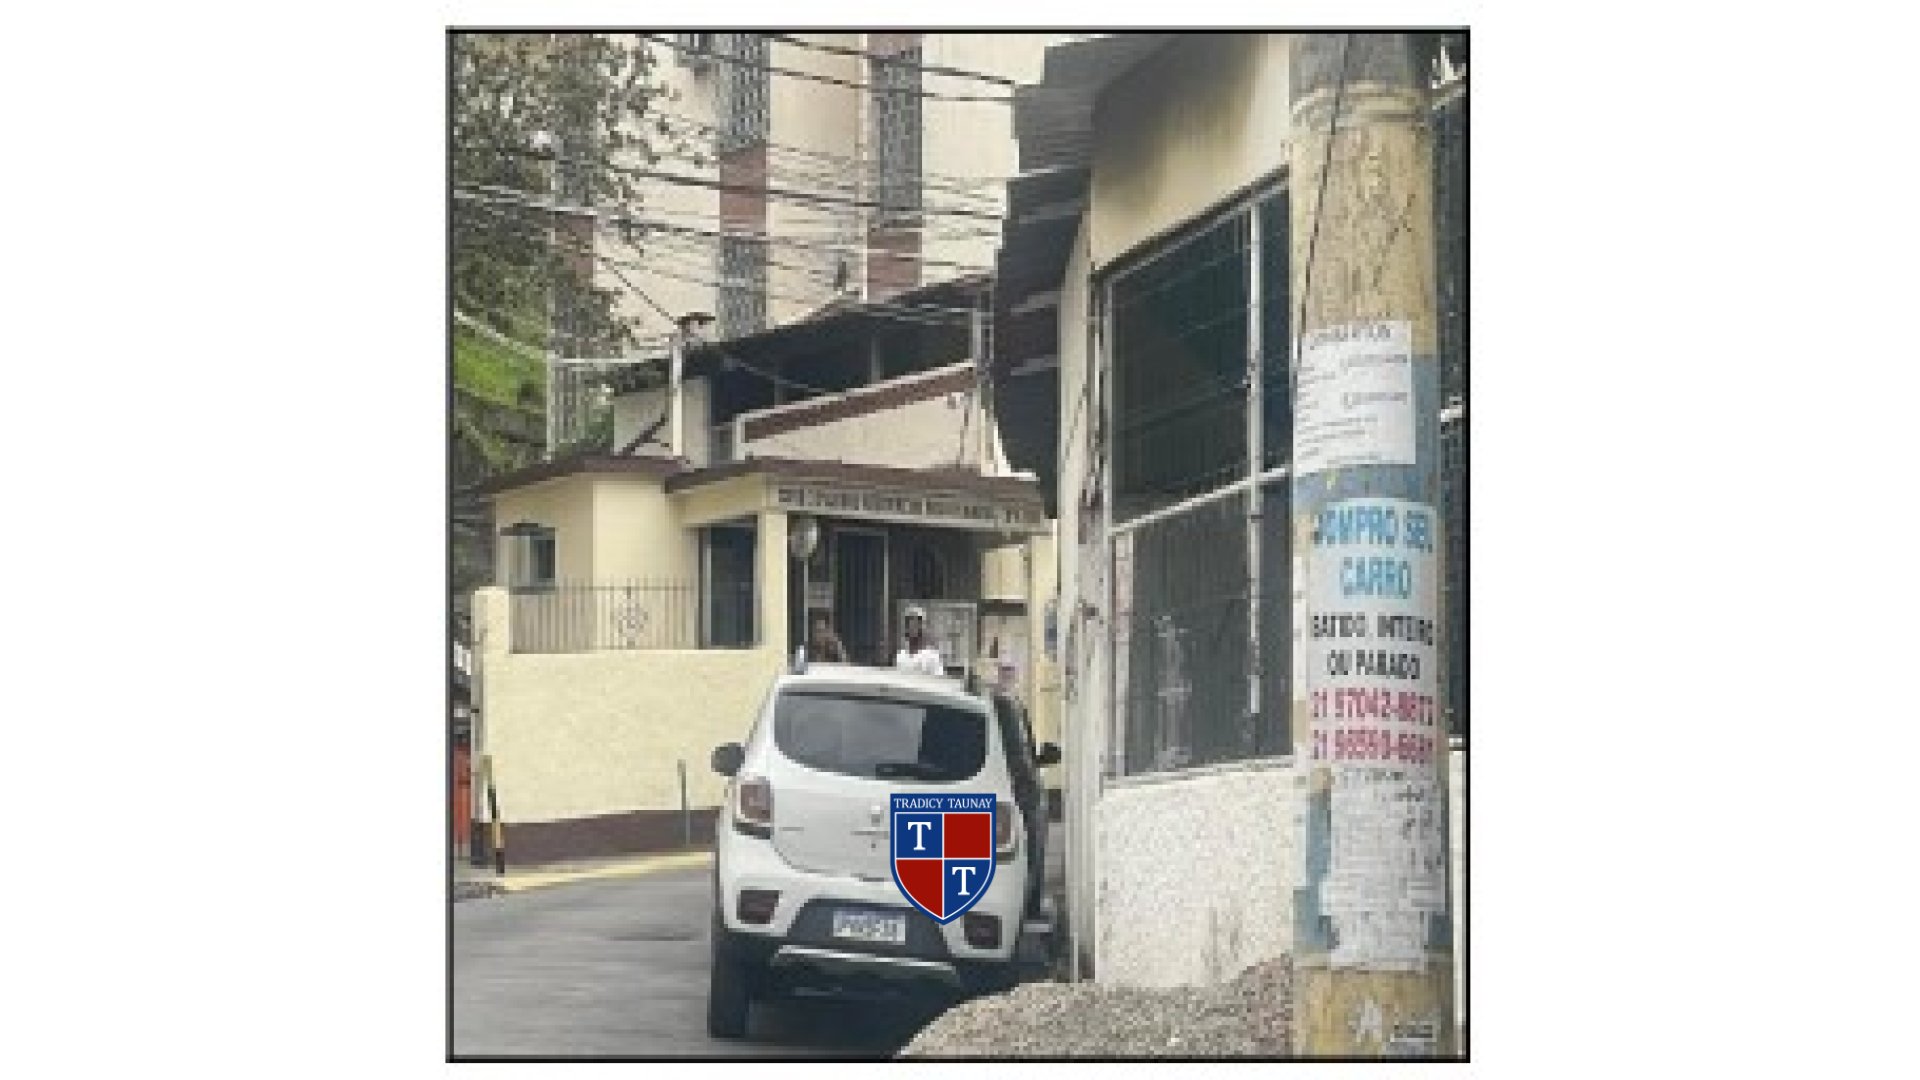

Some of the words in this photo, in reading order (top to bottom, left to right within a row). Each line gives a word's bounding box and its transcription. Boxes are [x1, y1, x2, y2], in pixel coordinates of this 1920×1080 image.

[1340, 557, 1412, 599] CARRO
[1326, 650, 1352, 677] OU
[1356, 650, 1421, 680] PARADO
